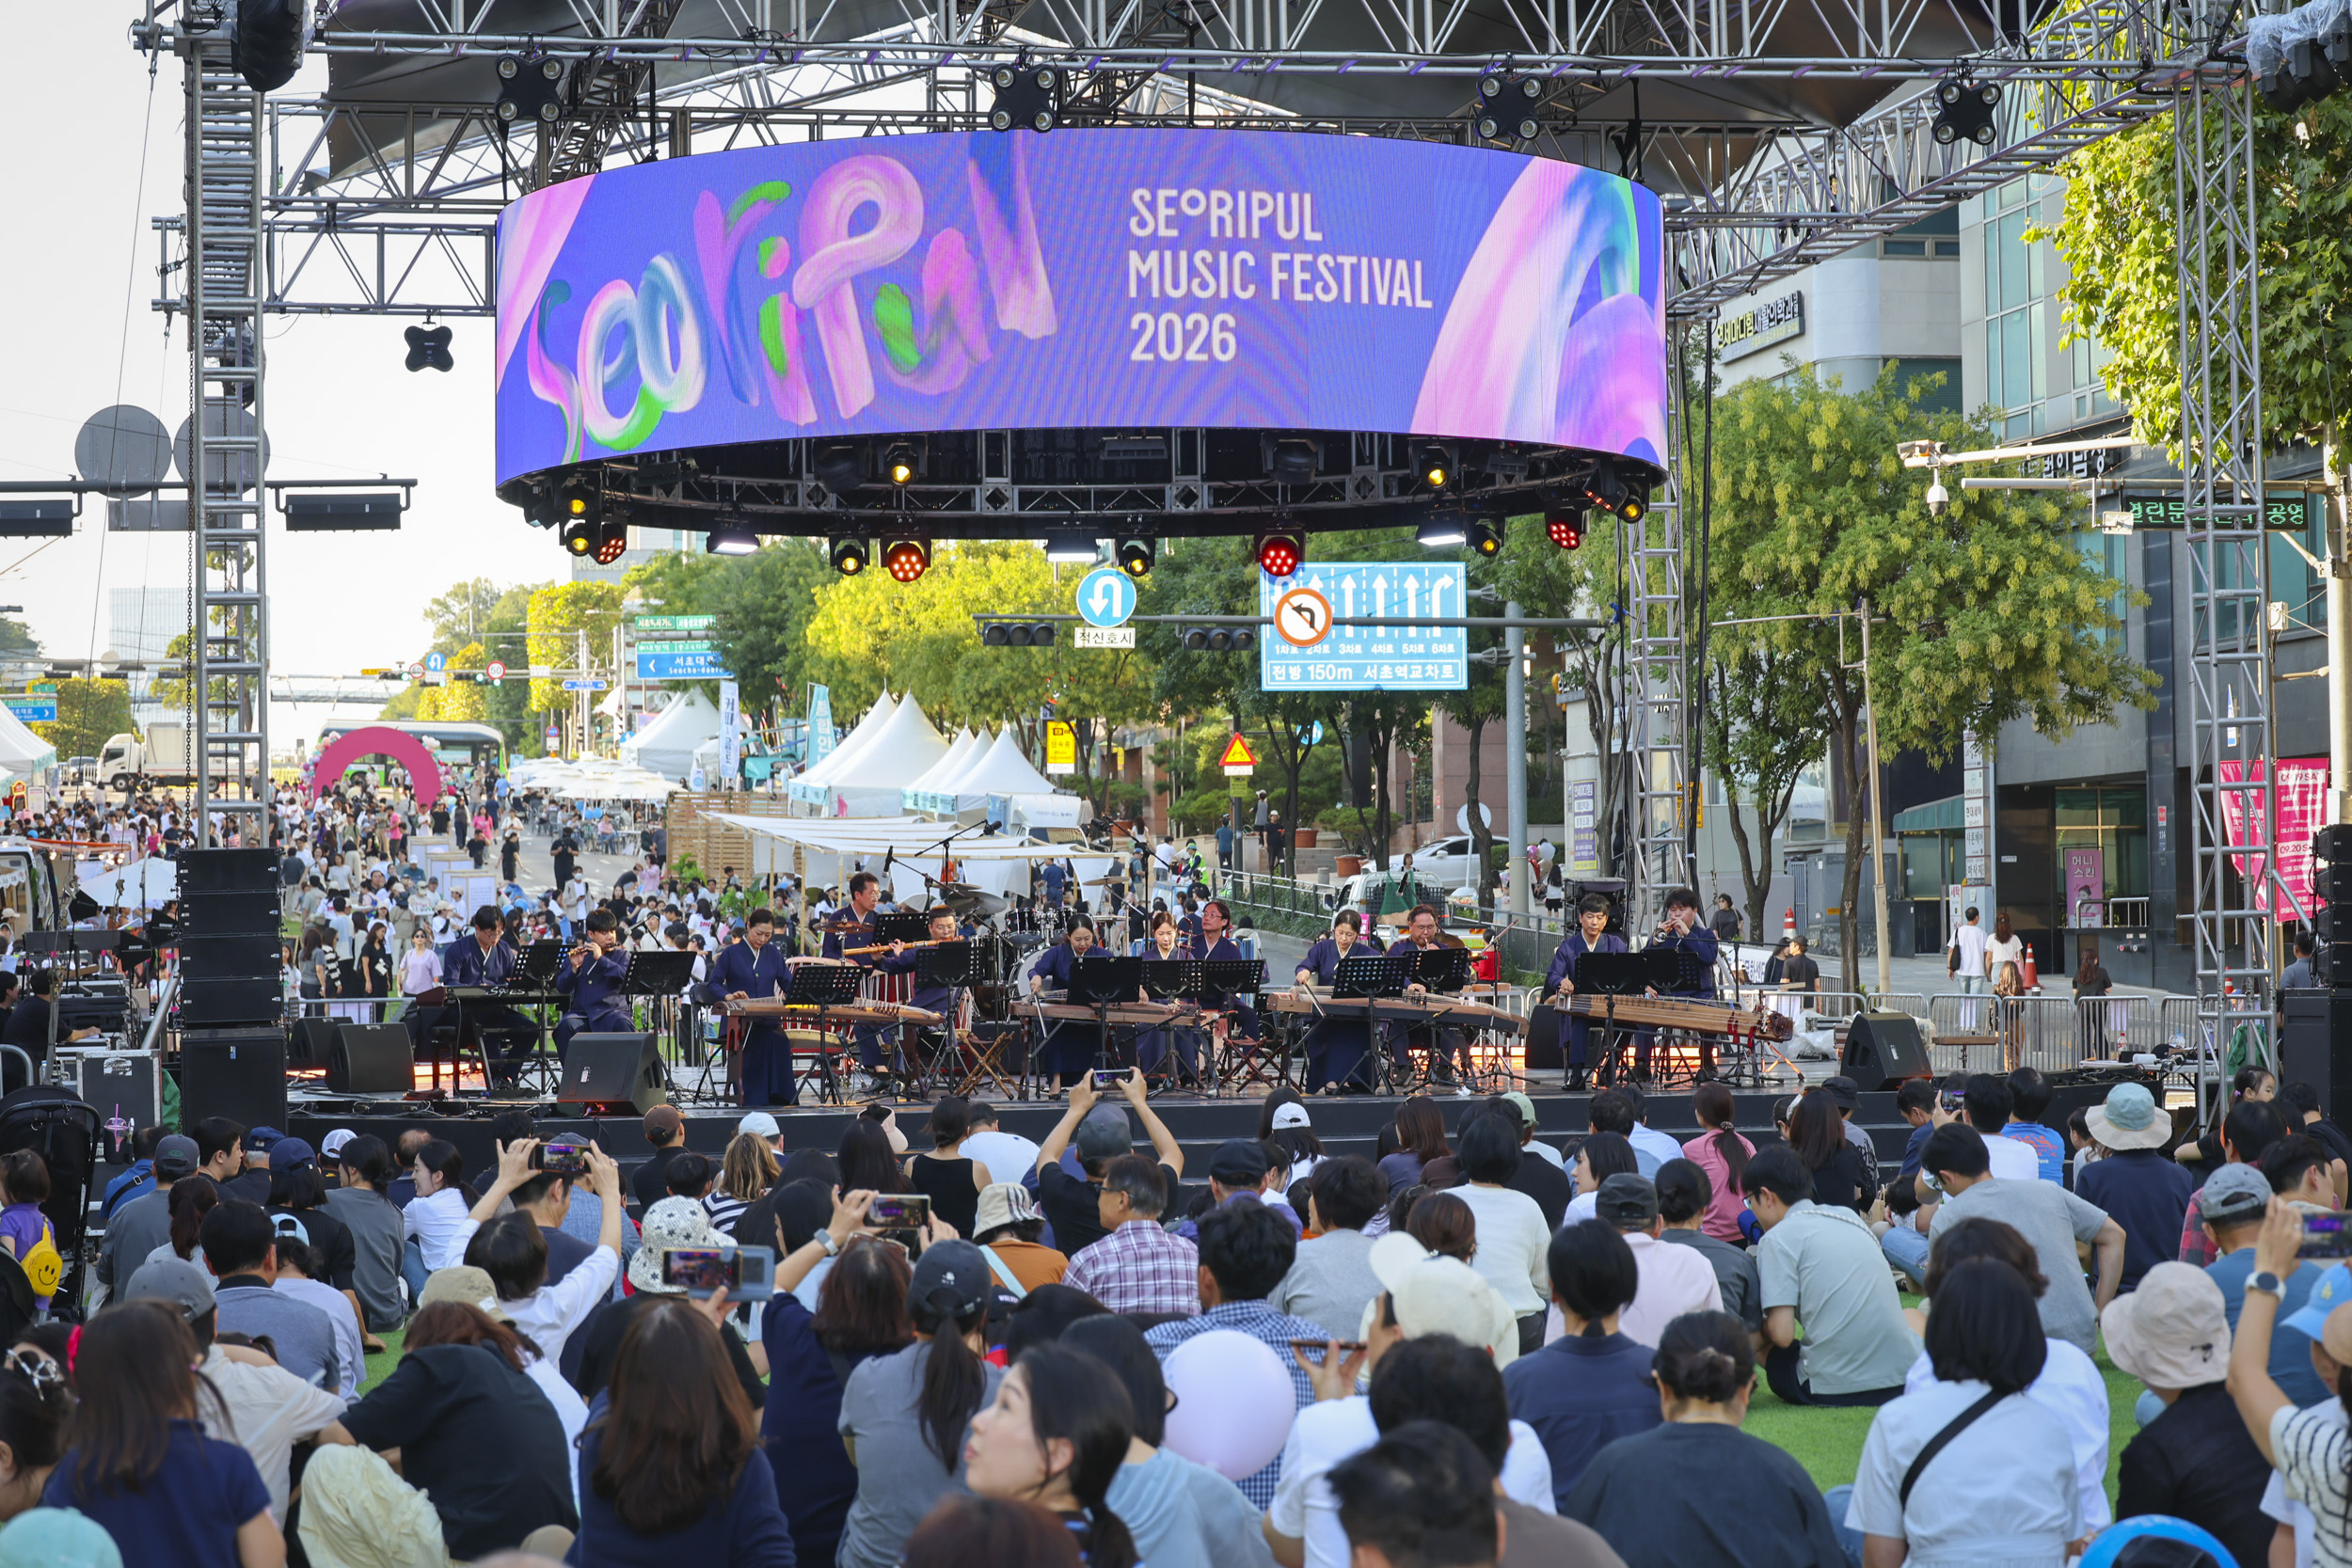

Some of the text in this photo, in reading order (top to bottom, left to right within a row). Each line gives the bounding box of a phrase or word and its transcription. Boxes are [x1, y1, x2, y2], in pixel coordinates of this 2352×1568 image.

[1130, 187, 1323, 242] SEORIPUL
[1128, 249, 1434, 309] MUSIC FESTIVAL
[1130, 311, 1237, 362] 2026
[2265, 502, 2304, 525] 공영
[1079, 631, 1132, 644] 적신호시
[1339, 643, 1363, 654] 3차로
[1371, 643, 1394, 654] 4차로
[1402, 643, 1425, 654] 5차로
[1431, 643, 1455, 654] 6차로
[1271, 664, 1455, 681] 전방 150m 서초역교차로
[2280, 843, 2302, 855] 09.20
[2074, 867, 2096, 879] 스킨
